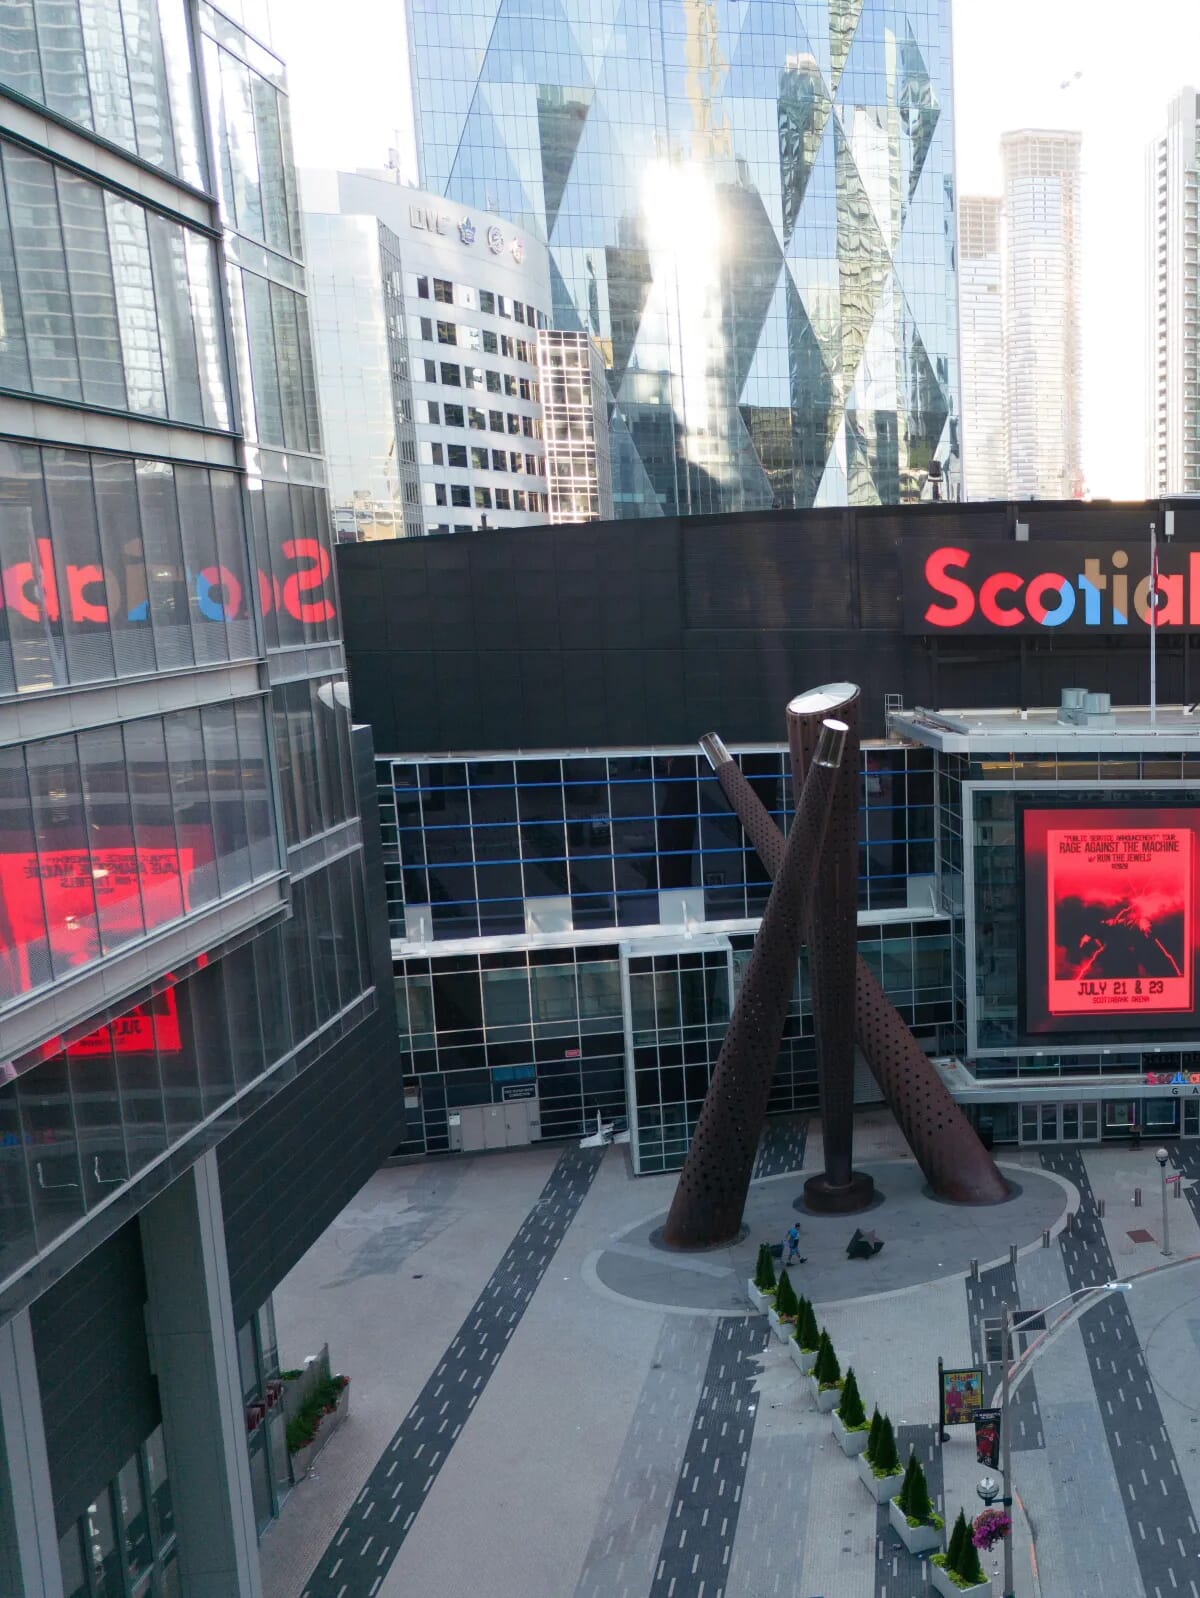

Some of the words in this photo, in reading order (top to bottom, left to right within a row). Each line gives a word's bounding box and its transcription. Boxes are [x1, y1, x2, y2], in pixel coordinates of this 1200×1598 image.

[1059, 843, 1081, 853] RAGE
[1085, 842, 1119, 853] AGAINST
[1122, 842, 1140, 852] THE
[1142, 841, 1180, 852] MACHINE
[1097, 854, 1112, 862] RUN
[1112, 854, 1126, 862] THE
[1126, 853, 1152, 862] JEWELS
[1078, 982, 1107, 995] JULY
[1113, 981, 1127, 994] 21
[1135, 980, 1142, 994] &
[1149, 980, 1164, 994] 23
